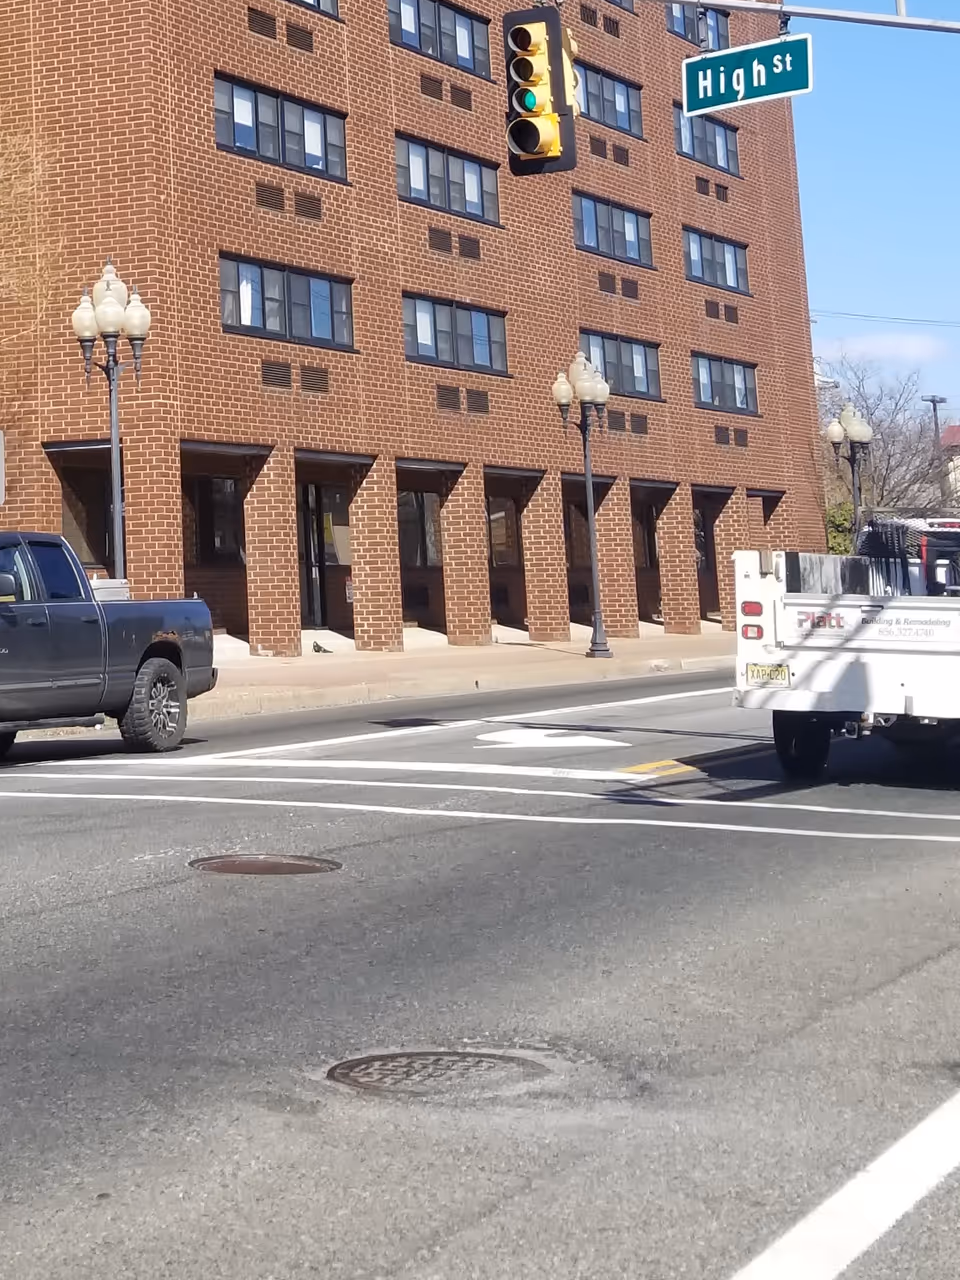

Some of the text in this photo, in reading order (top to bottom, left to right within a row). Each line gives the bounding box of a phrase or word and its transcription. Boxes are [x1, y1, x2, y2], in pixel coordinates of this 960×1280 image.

[697, 52, 793, 101] High St
[796, 611, 844, 629] Platt
[861, 617, 951, 628] Building & Remodeling
